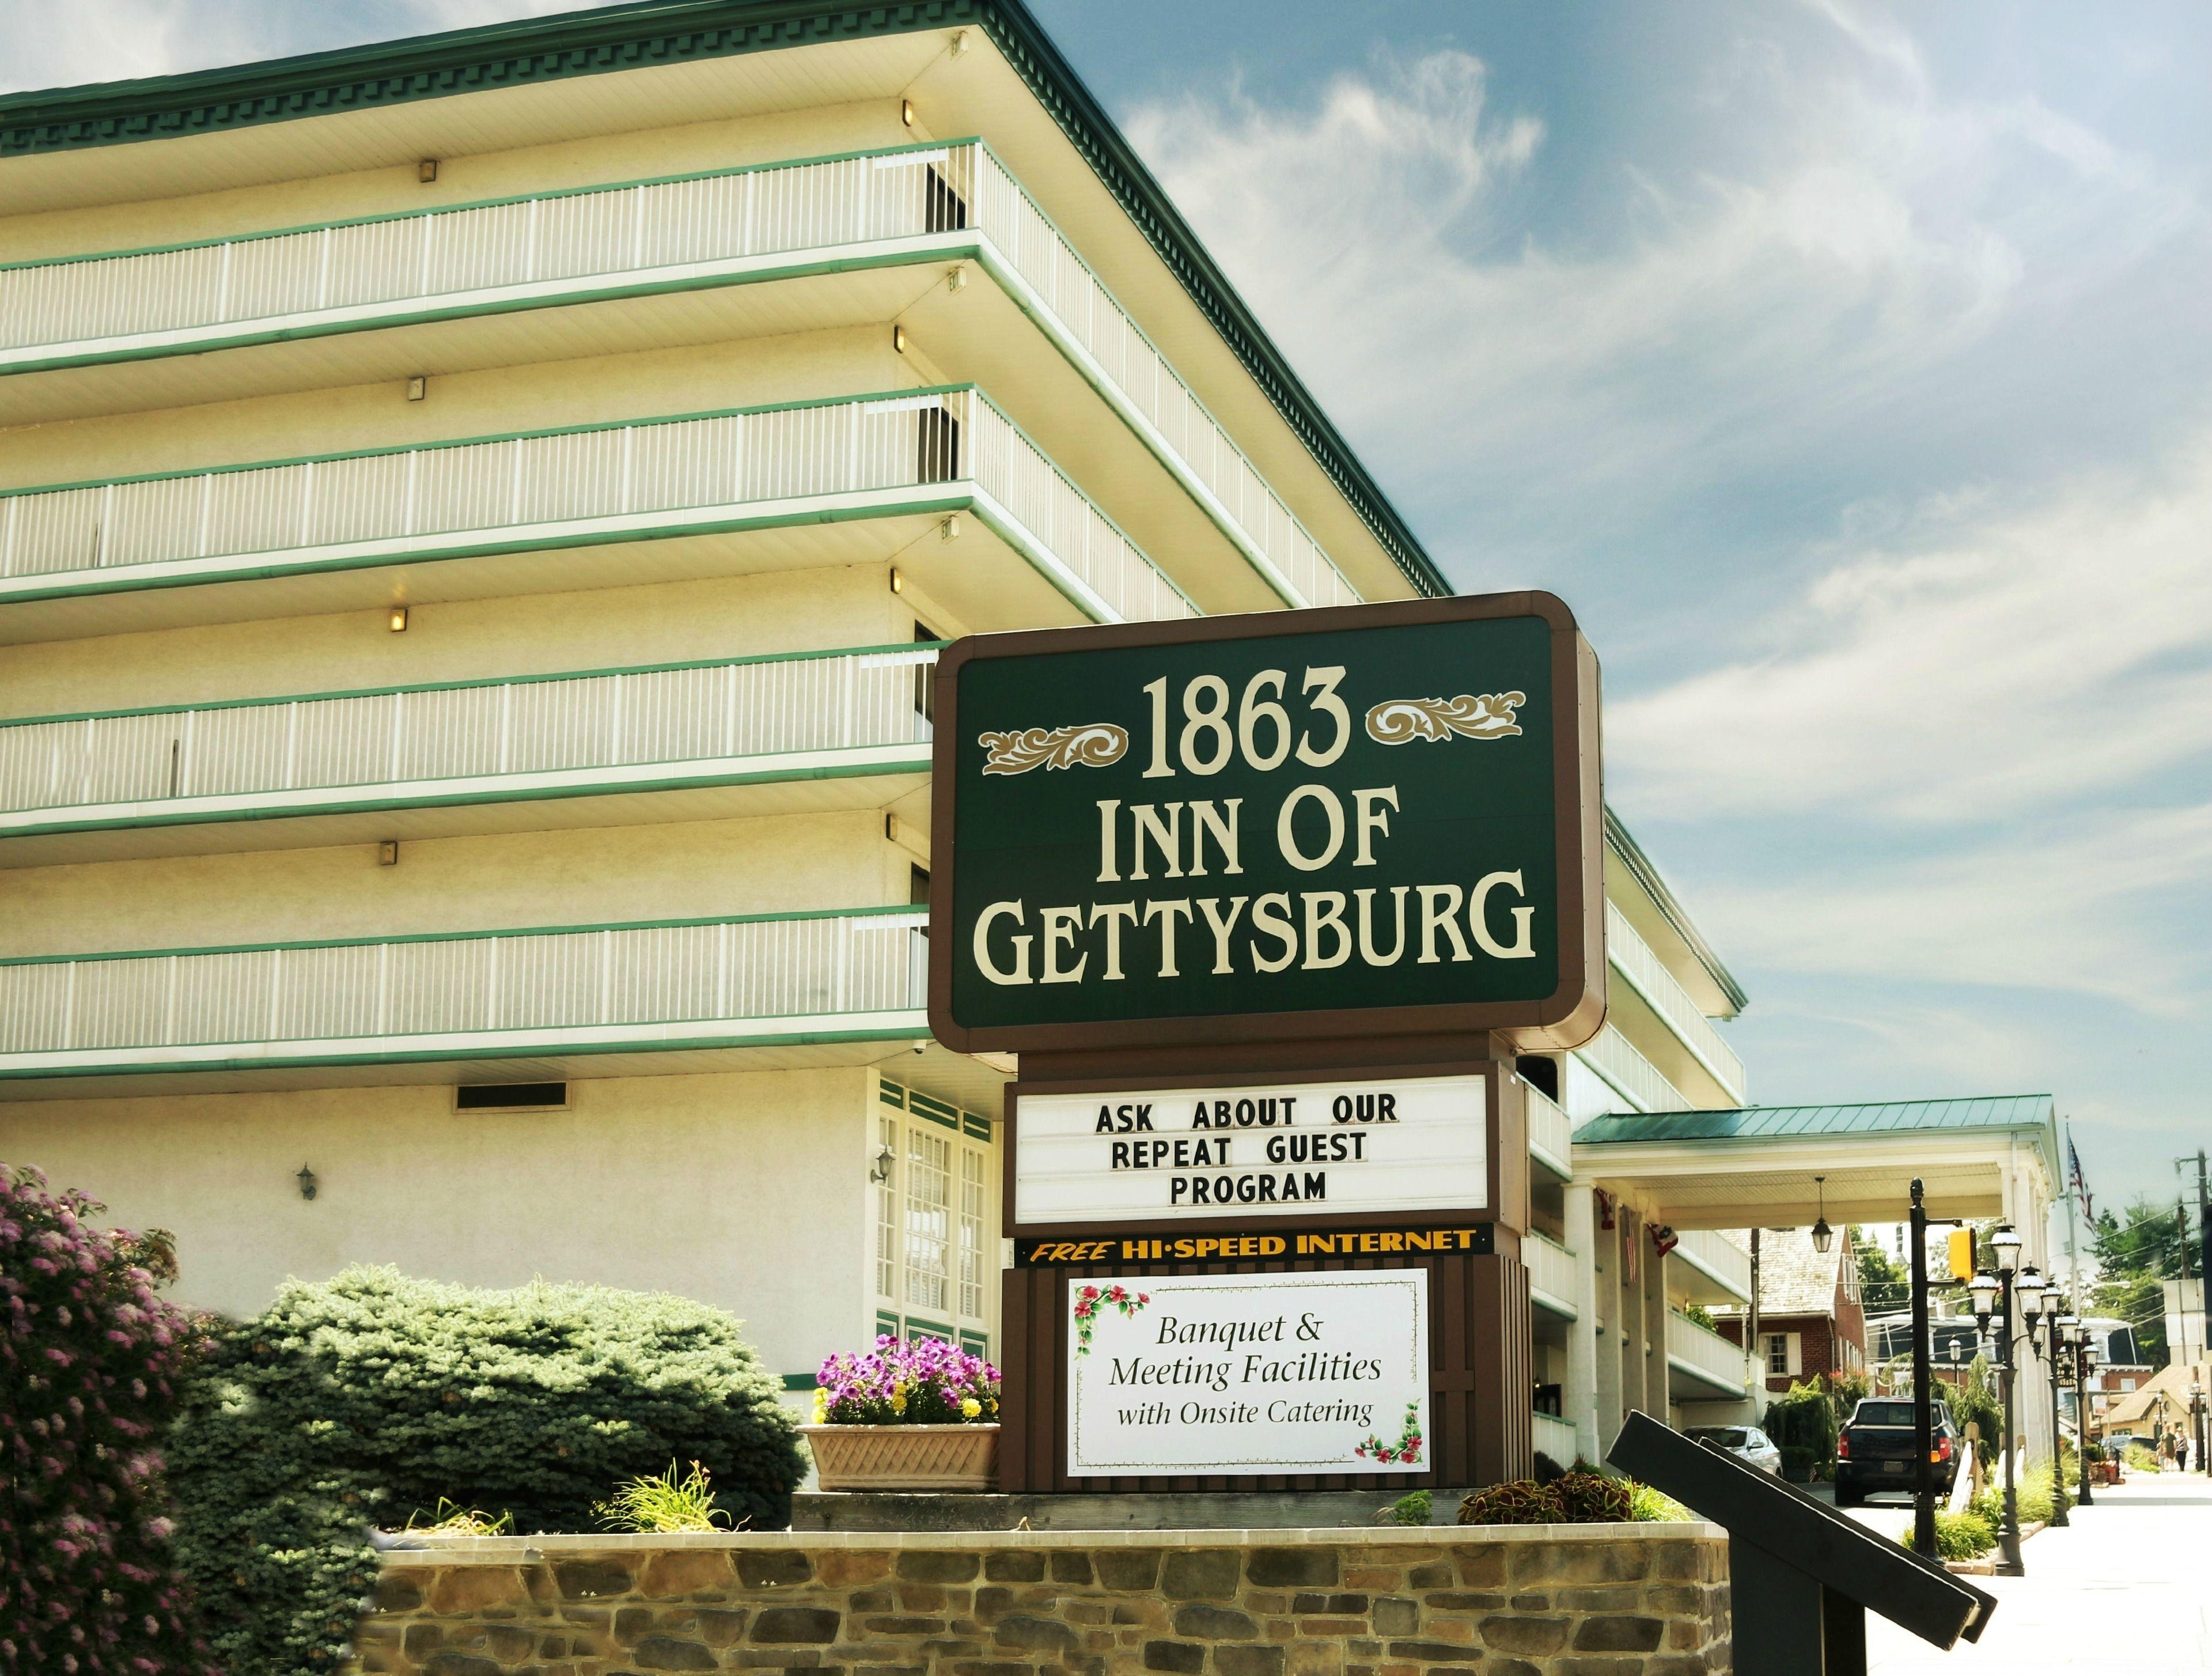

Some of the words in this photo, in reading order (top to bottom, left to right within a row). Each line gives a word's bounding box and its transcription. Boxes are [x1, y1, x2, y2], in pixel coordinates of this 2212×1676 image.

[1143, 665, 1350, 778] 1863
[1097, 799, 1243, 882] INN
[1278, 785, 1399, 871] OF
[974, 869, 1535, 985] GETTYSBURG
[1096, 1105, 1153, 1133] ASK
[1193, 1098, 1296, 1129] ABOUT
[1333, 1094, 1397, 1123] OUR
[1112, 1138, 1230, 1168] REPEAT
[1267, 1133, 1366, 1163] GUEST
[1171, 1172, 1325, 1204] PROGRAM
[1030, 1242, 1116, 1262] FREE
[1297, 1230, 1476, 1254] INTERNET
[1156, 1316, 1286, 1352] Banquet
[1296, 1313, 1324, 1341] &
[1109, 1356, 1232, 1392] Meeting
[1241, 1352, 1381, 1383] Facilities
[1118, 1402, 1171, 1425] with
[1180, 1402, 1259, 1424] Onsite
[1267, 1400, 1374, 1428] Catering
